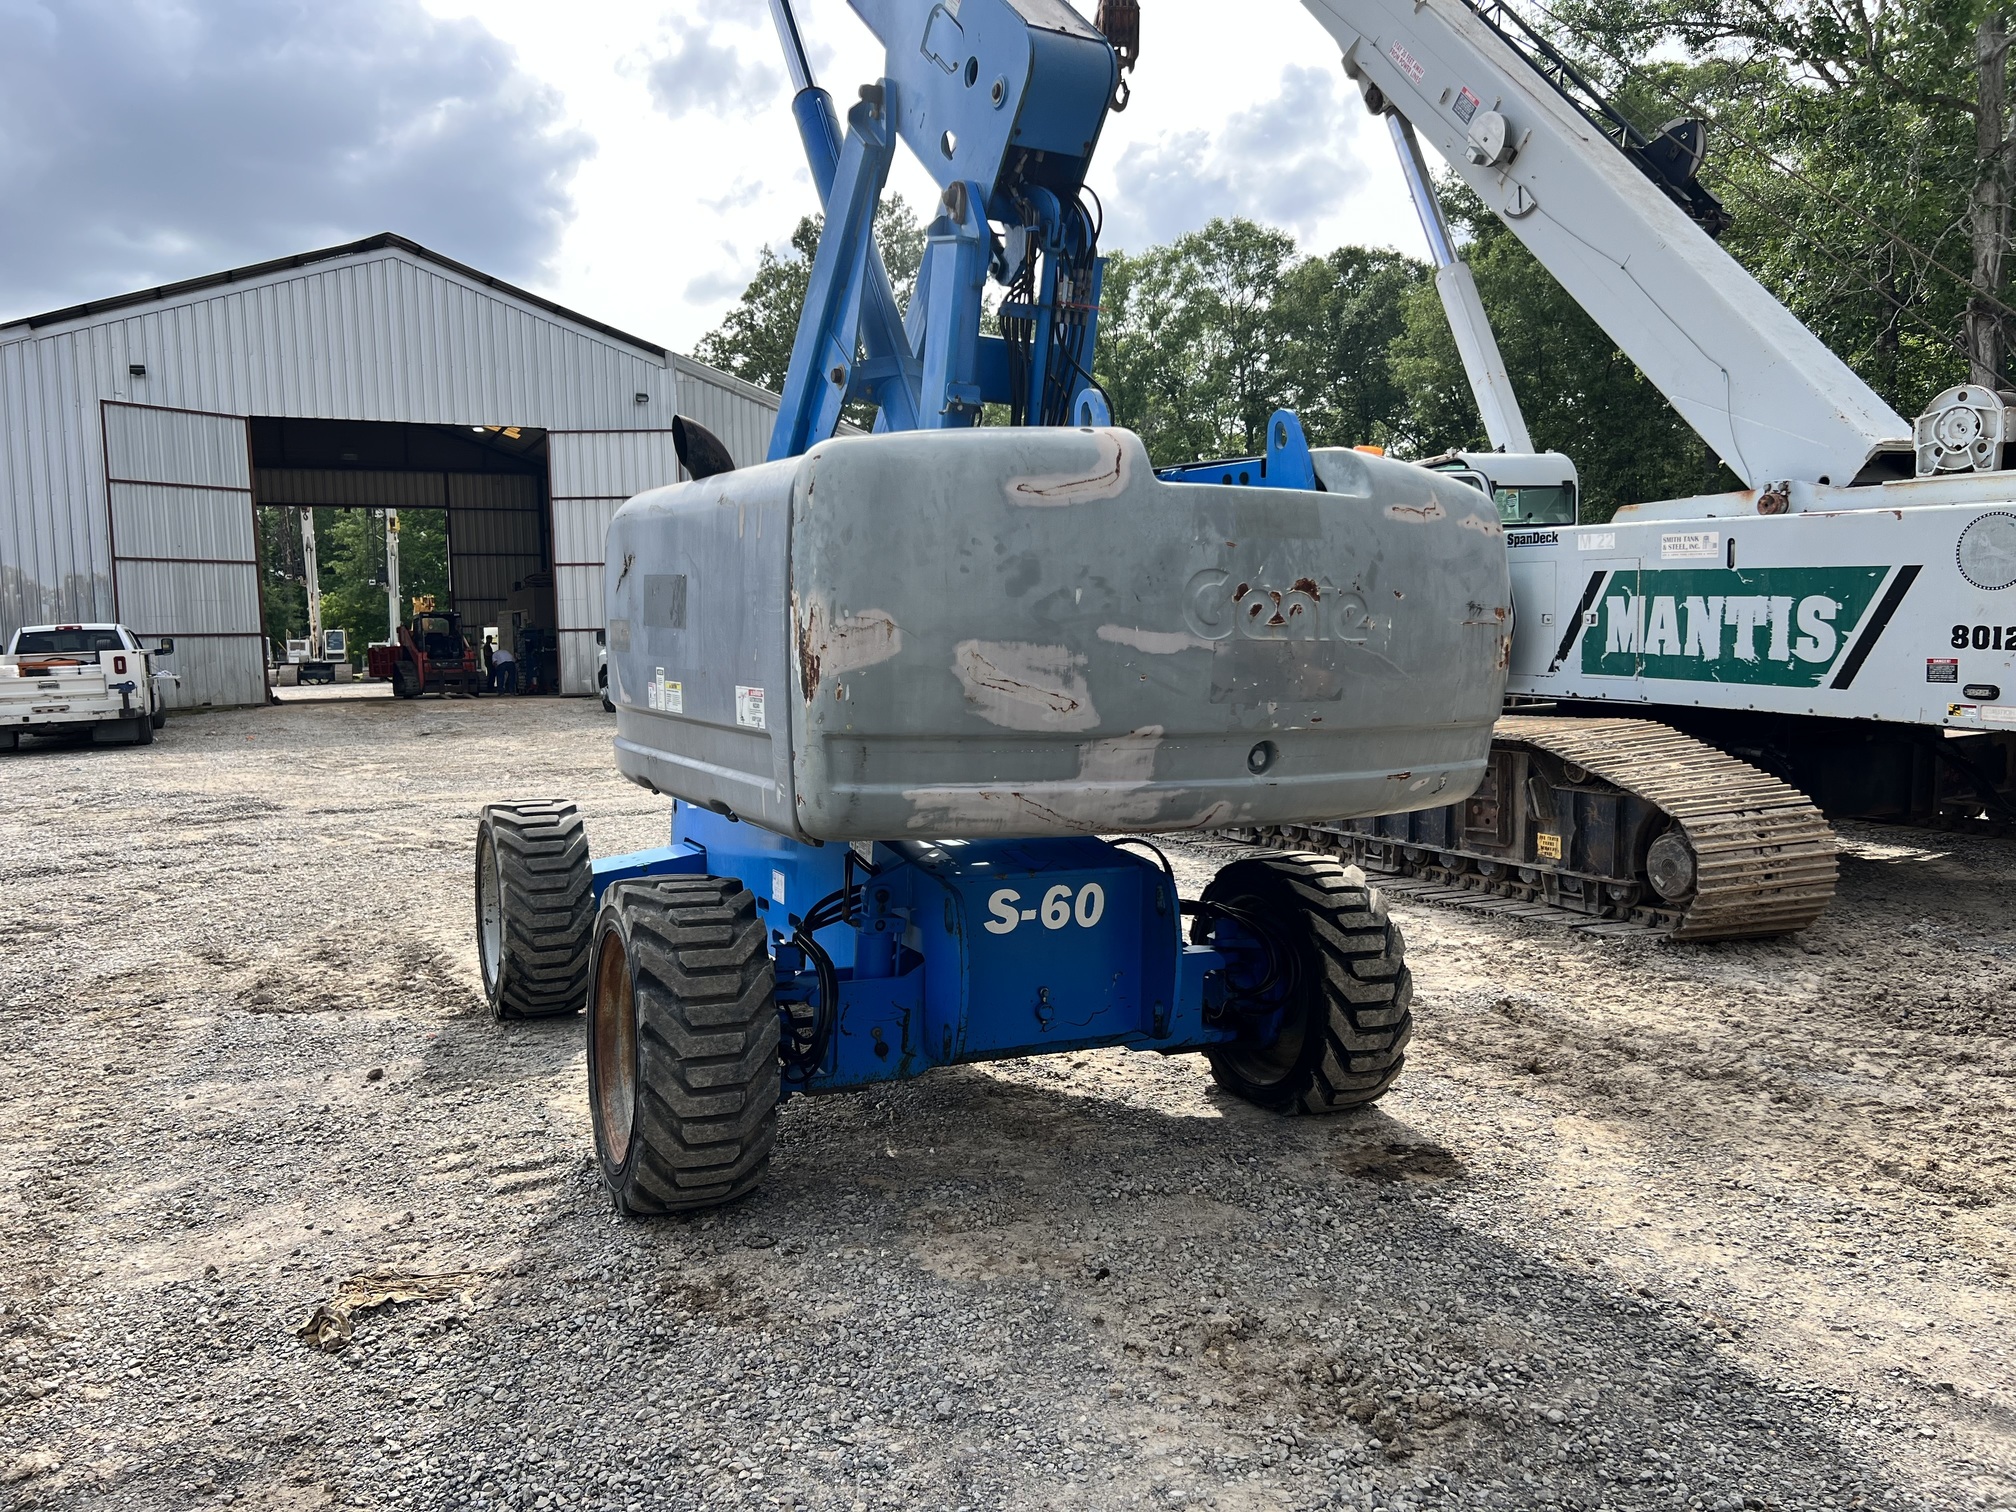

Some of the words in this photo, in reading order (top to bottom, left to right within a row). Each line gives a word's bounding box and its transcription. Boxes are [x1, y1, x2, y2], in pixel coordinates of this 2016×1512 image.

[1389, 47, 1400, 61] FROM
[1399, 57, 1412, 74] POWER
[1410, 70, 1422, 85] LINES
[1406, 53, 1415, 66] FEET
[1413, 62, 1425, 76] AWAY
[1507, 531, 1558, 548] SpanDeck
[1580, 534, 1591, 549] M
[1683, 535, 1699, 543] TANK
[1182, 568, 1368, 640] Genie
[1606, 595, 1838, 663] MANTIS
[983, 882, 1105, 935] S-60
